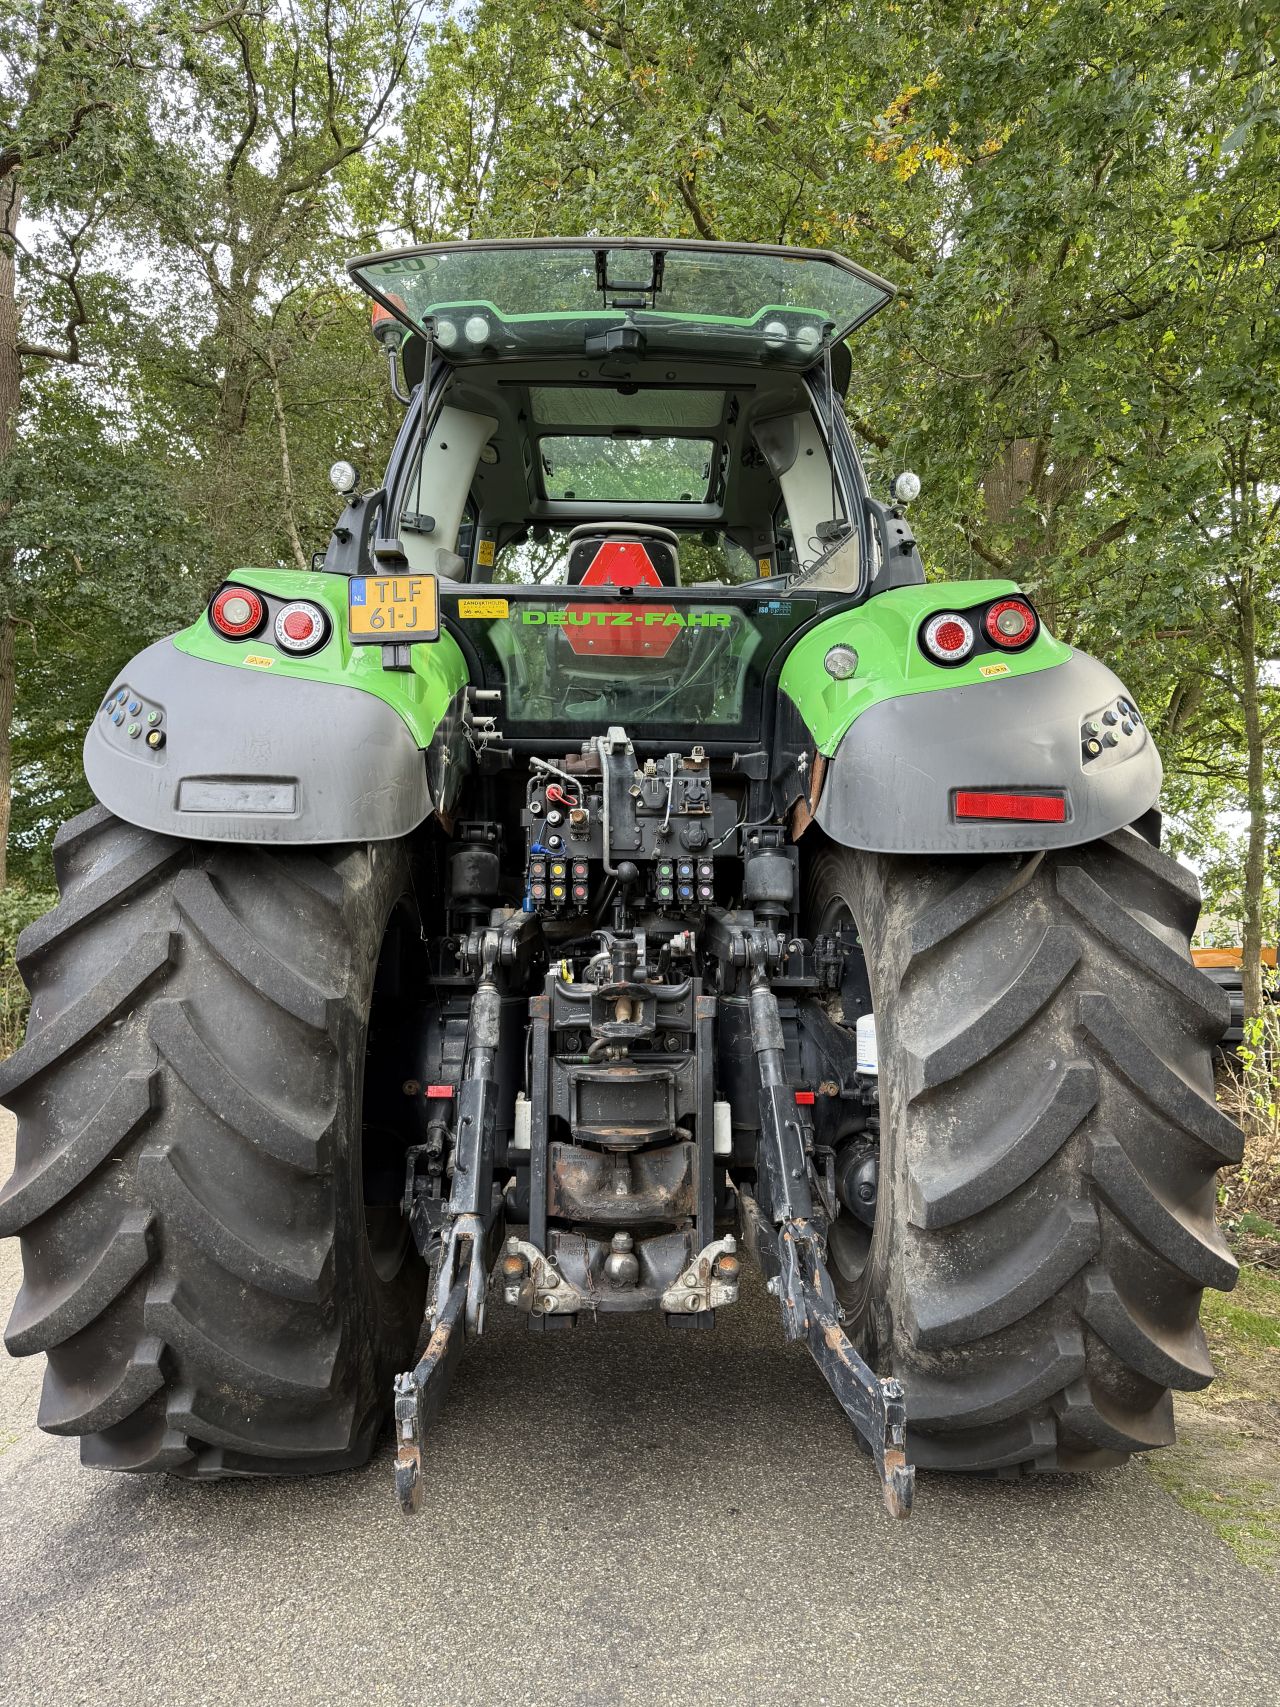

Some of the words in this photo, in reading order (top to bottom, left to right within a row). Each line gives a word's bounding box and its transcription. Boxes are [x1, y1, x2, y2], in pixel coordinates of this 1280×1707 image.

[375, 580, 421, 602] TLF
[370, 606, 418, 629] 61-J
[522, 611, 731, 627] DEUTZ-FAHR
